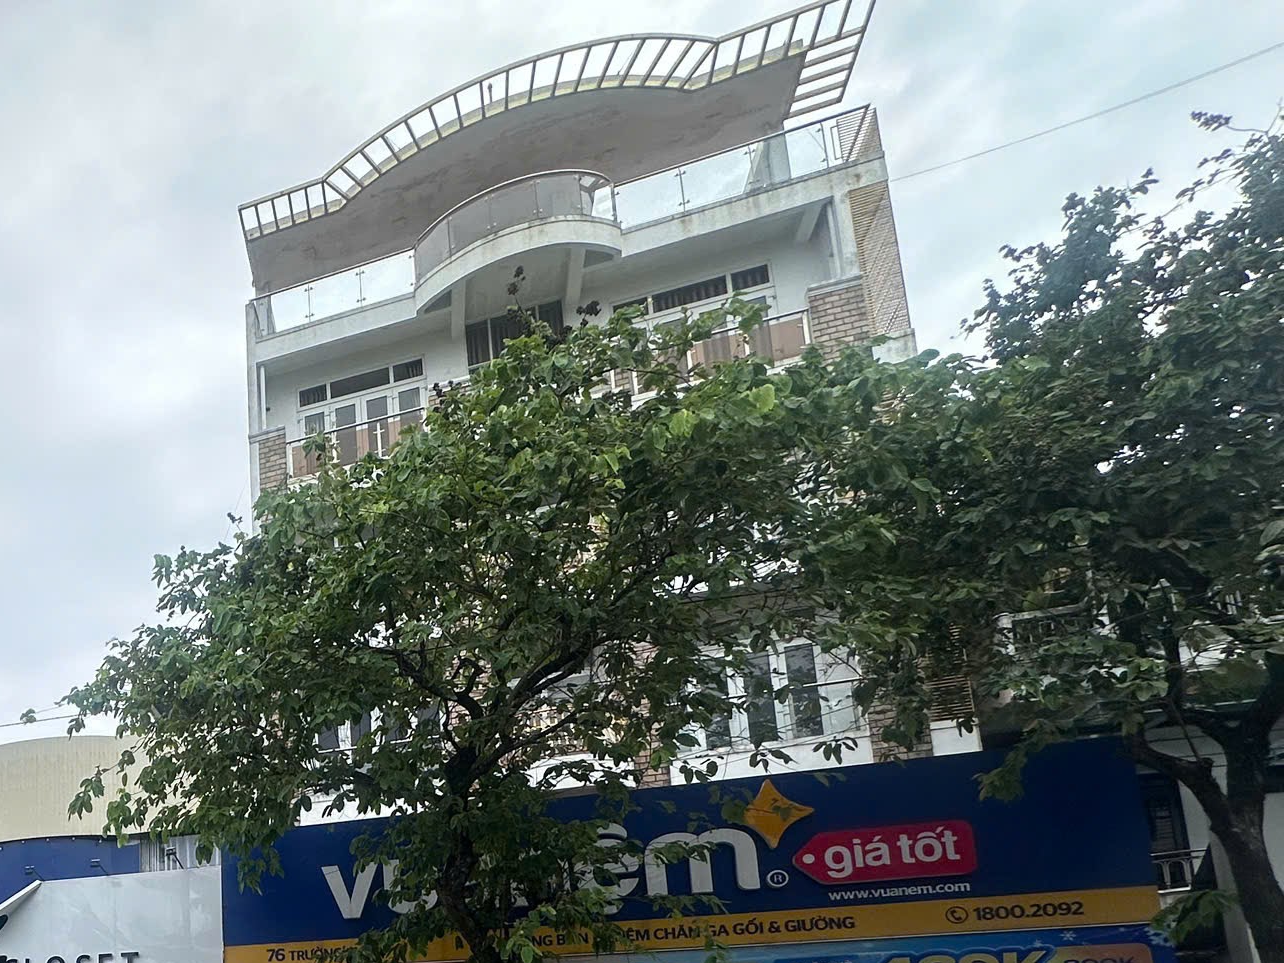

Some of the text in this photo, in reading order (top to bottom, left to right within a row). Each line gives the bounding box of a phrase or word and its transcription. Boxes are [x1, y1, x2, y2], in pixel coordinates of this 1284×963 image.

[823, 826, 961, 879] giá tốt
[828, 880, 972, 901] www.vuanem.com
[973, 901, 1085, 922] 1800.2092
[733, 918, 764, 936] GỐI
[768, 921, 782, 934] &
[784, 915, 856, 933] GIƯỜNG
[267, 948, 286, 963] 76
